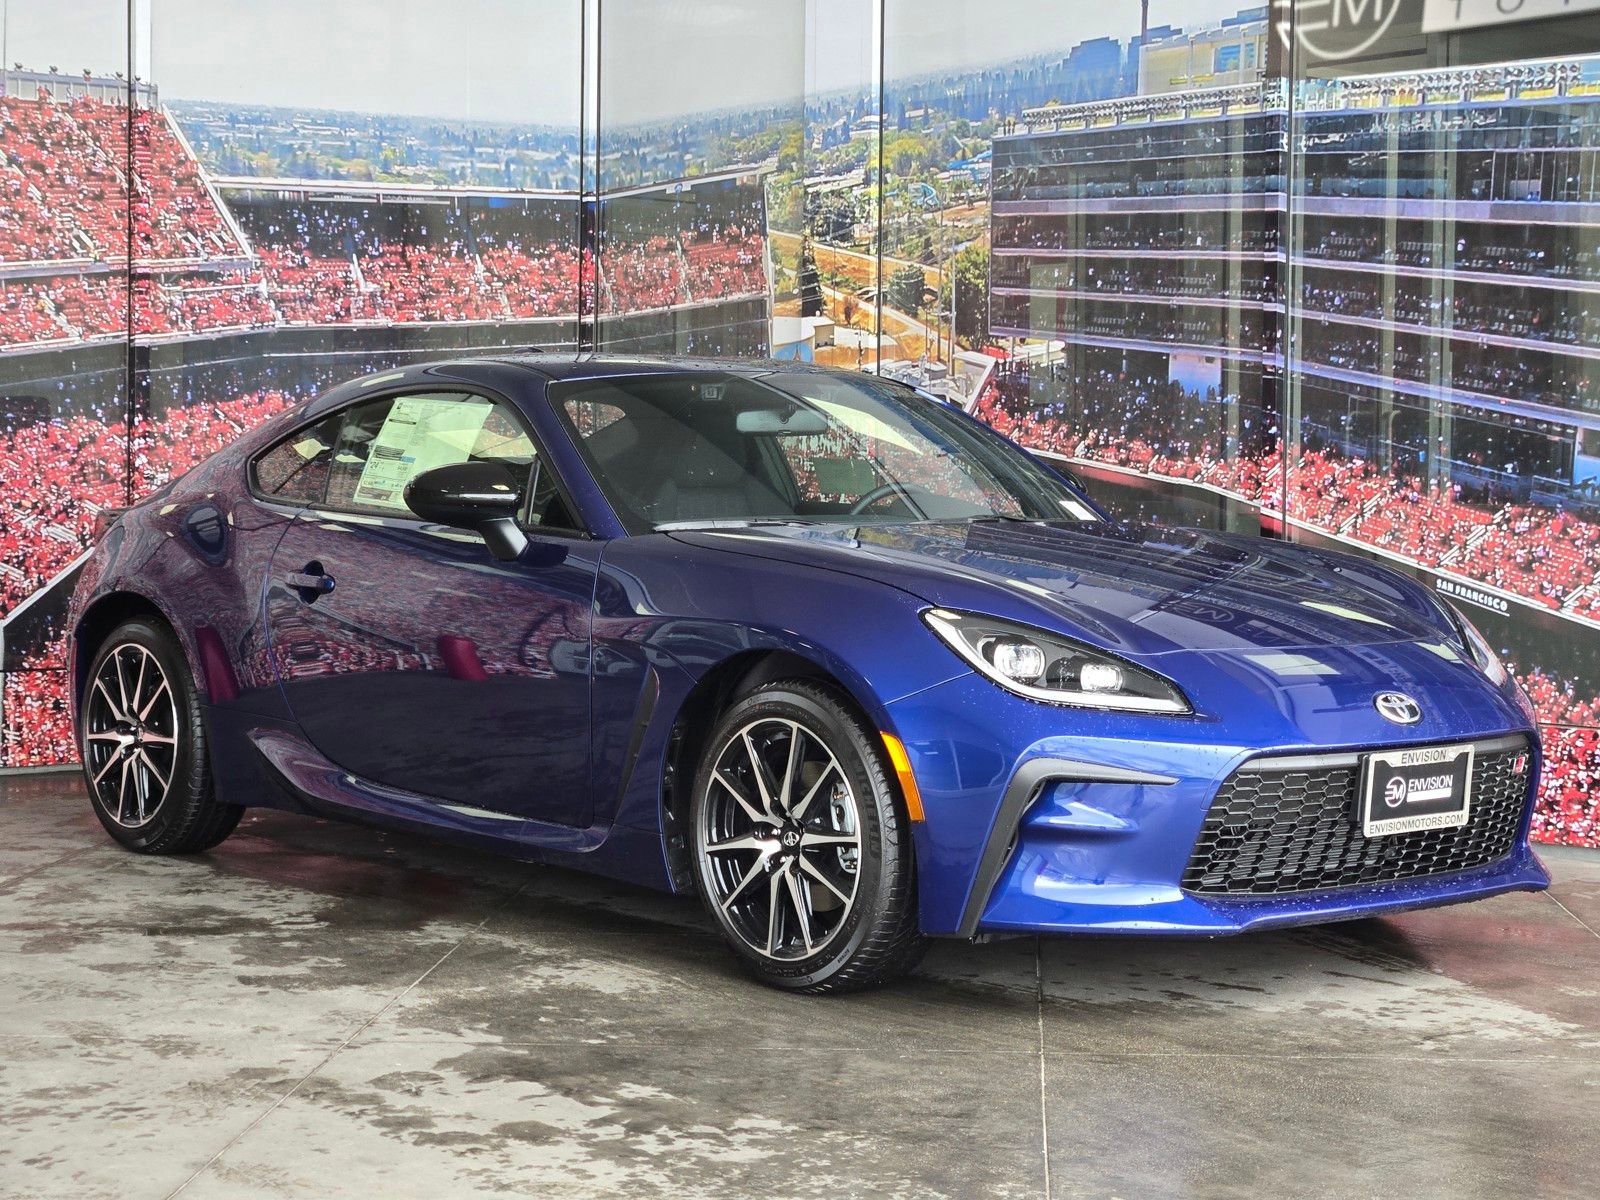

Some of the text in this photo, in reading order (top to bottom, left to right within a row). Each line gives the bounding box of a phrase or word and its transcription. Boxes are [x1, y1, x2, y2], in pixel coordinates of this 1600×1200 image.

[1436, 579, 1508, 611] SAN FRANCISCO
[1401, 750, 1447, 764] ENVISION
[1408, 775, 1453, 791] ENVISION
[1369, 814, 1464, 834] ENVISIONMOTORS.COM
